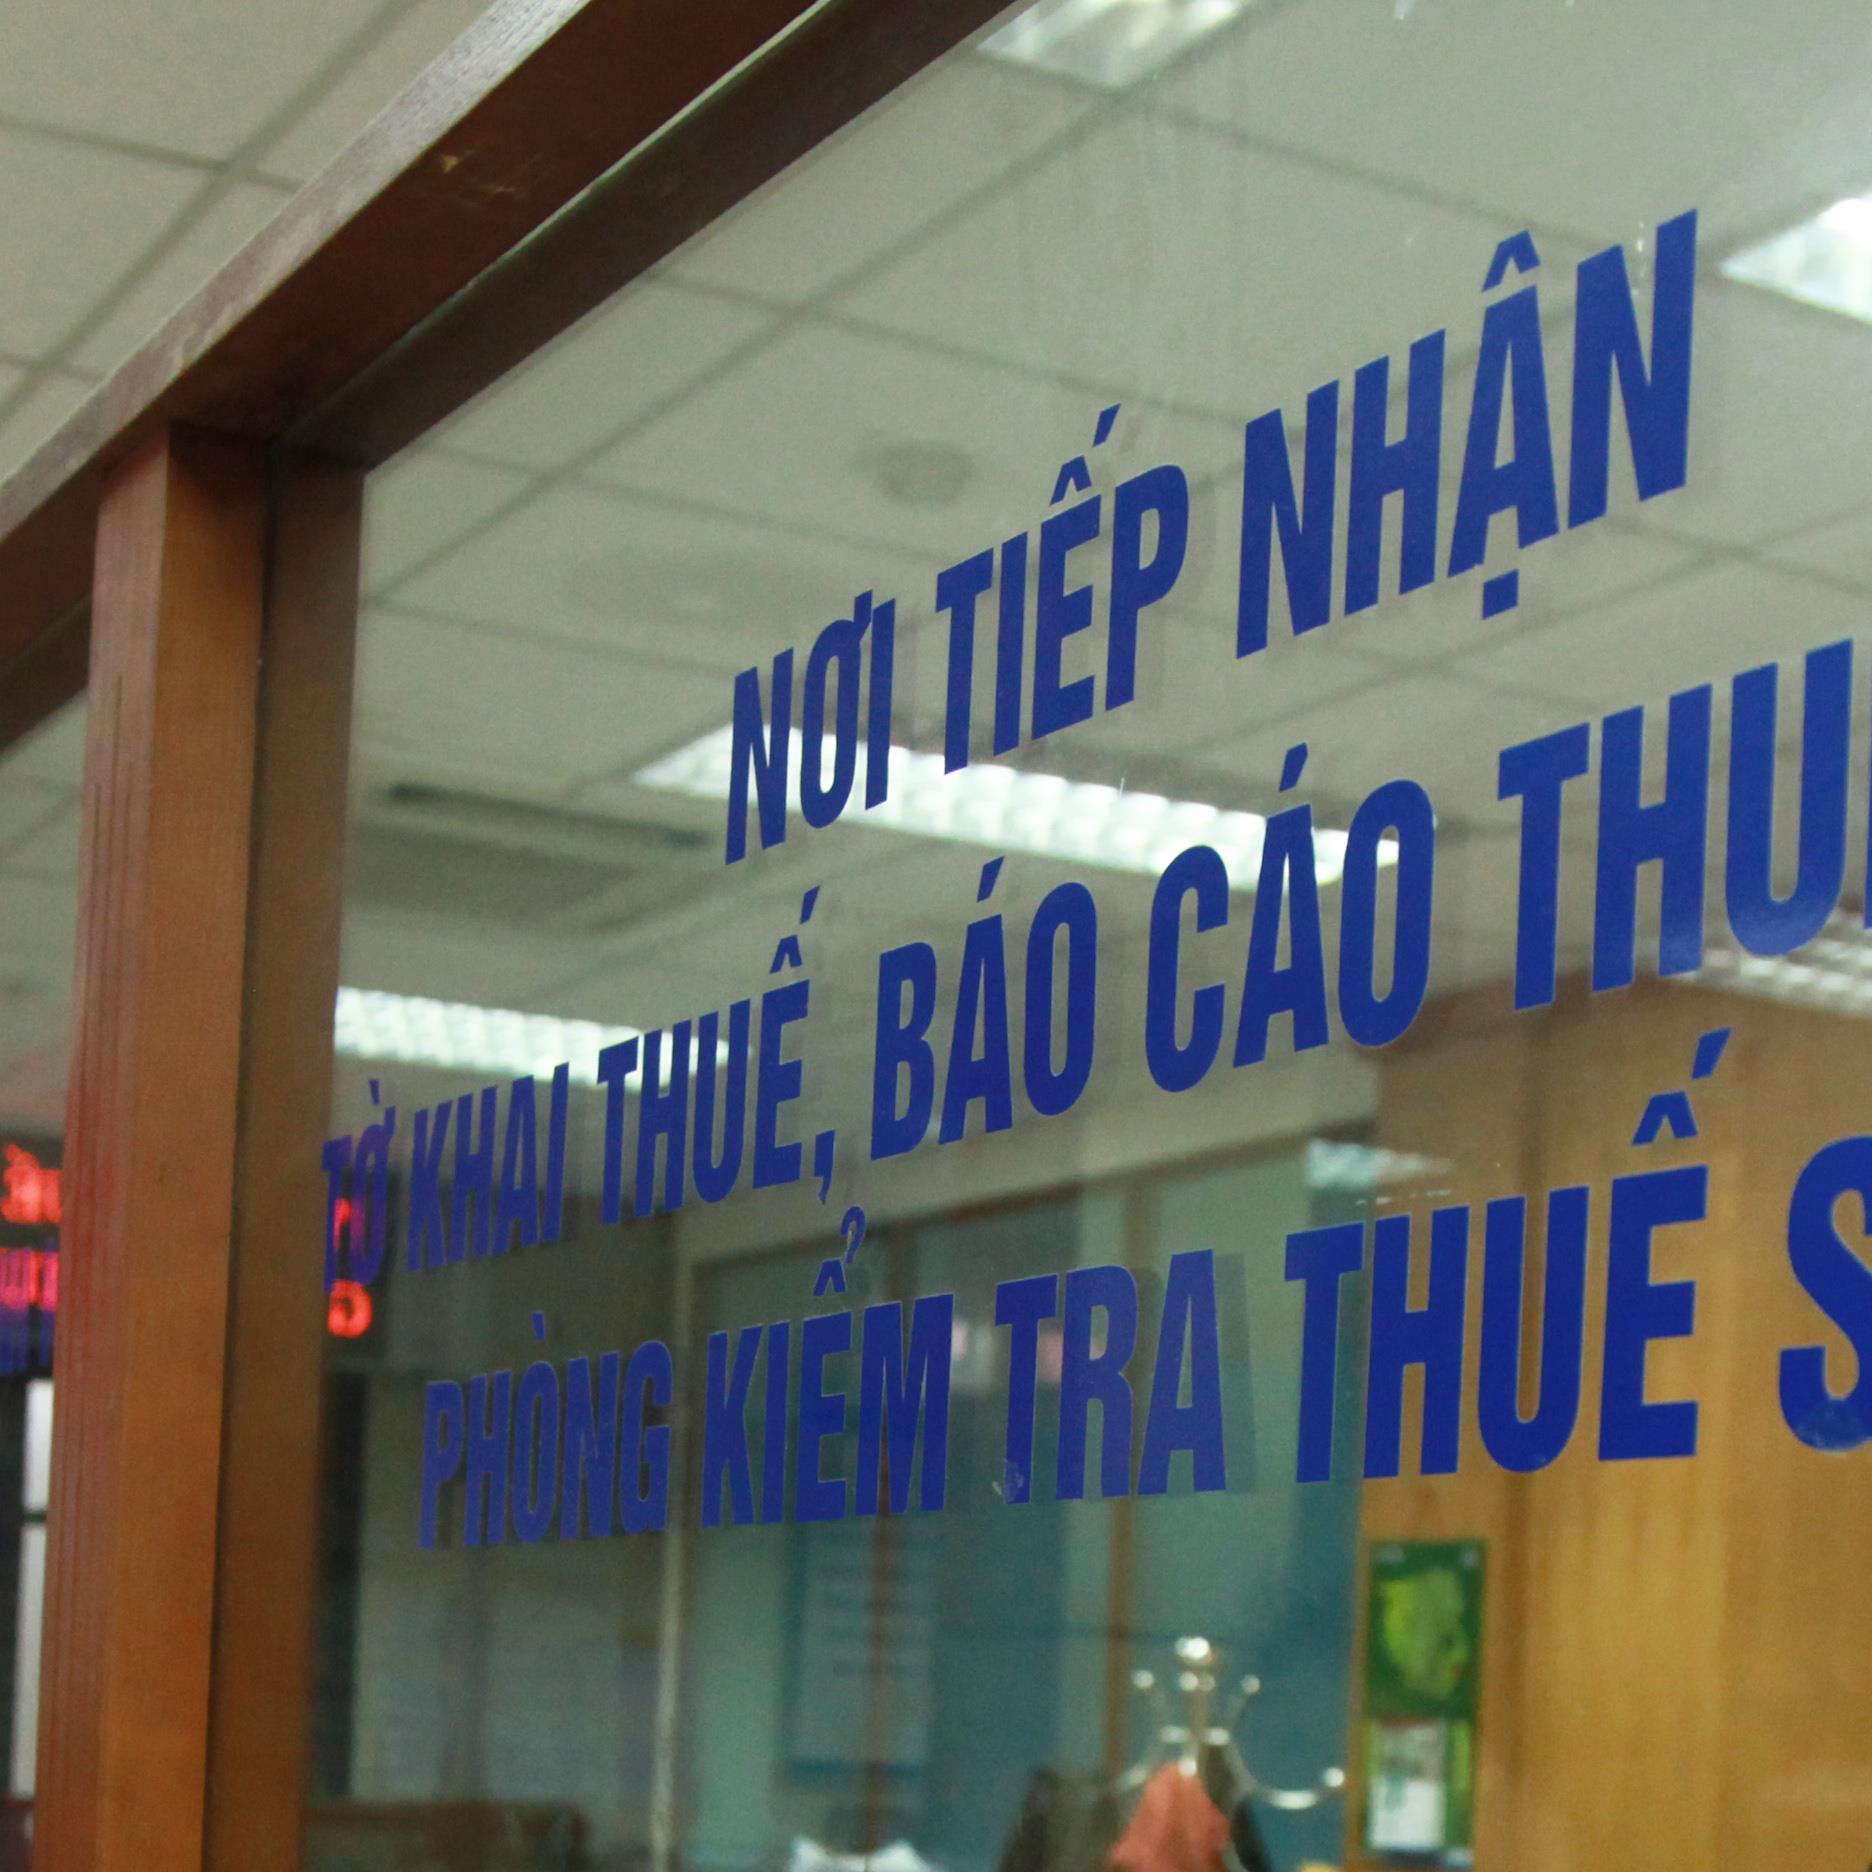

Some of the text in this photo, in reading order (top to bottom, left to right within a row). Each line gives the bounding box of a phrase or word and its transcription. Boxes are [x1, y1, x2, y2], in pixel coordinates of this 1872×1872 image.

[727, 211, 1696, 863] NƠI TIẾP NHẬN
[322, 1079, 395, 1293] TỜ
[406, 1063, 569, 1272] KHAI
[598, 889, 836, 1224] THUẾ,
[871, 859, 1097, 1159] BÁO
[1146, 745, 1435, 1092] CÁO
[420, 1313, 672, 1547] PHÒNG
[703, 1207, 954, 1527] KIỂM
[996, 1250, 1225, 1504] TRA
[1286, 1029, 1730, 1484] THUẾ
